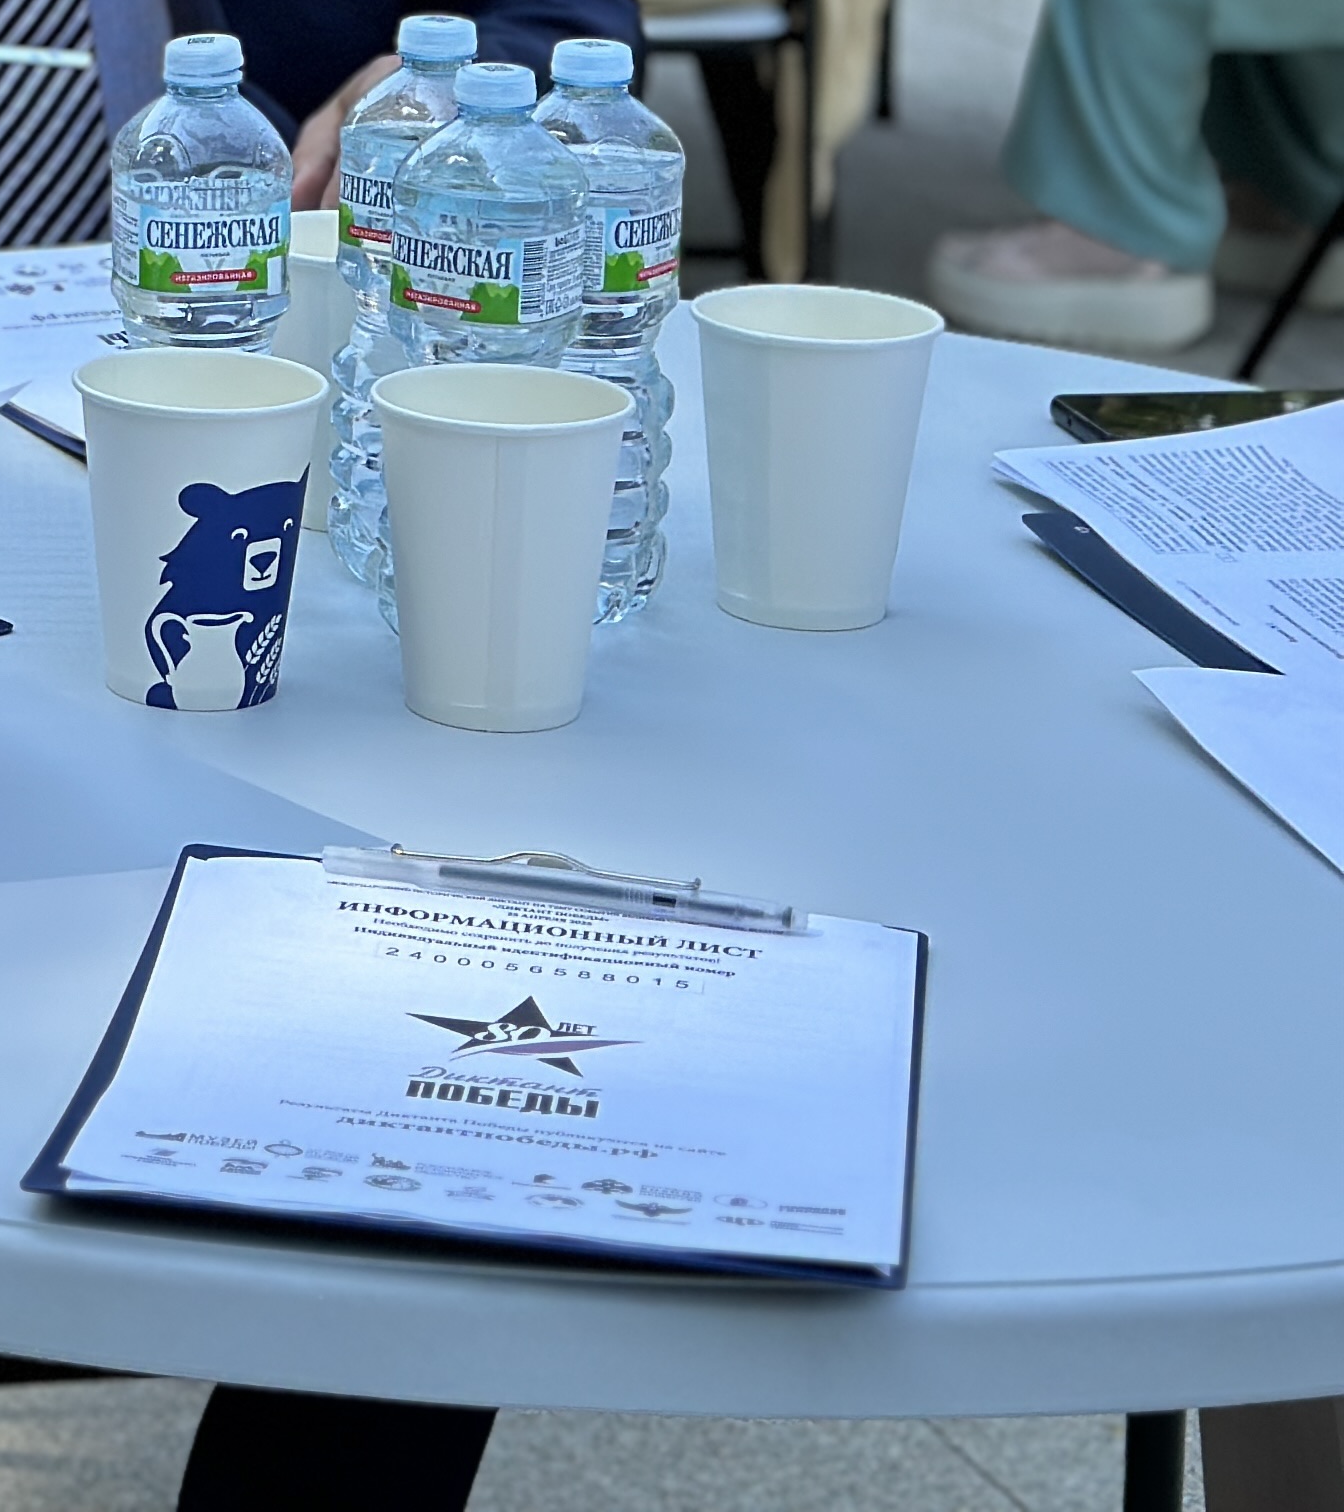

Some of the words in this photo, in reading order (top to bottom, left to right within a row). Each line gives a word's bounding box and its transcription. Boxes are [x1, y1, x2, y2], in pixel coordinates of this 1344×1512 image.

[146, 216, 281, 250] СЕНЕЖСКАЯ
[174, 271, 253, 282] НЕГАЗИРОВАННАЯ
[337, 900, 668, 948] ИНФОРМАЦИОННЫЙ
[676, 938, 763, 959] ЛИСТ
[354, 926, 498, 951] Индивидуальный
[501, 946, 680, 971] идентификационный
[685, 965, 736, 978] номер
[473, 1022, 551, 1042] 80
[557, 1021, 598, 1035] ЛЕТ
[408, 1065, 603, 1098] Диктант
[405, 1079, 600, 1119] ПОБЕДЫ
[335, 1116, 659, 1159] диктантпобеды.рф
